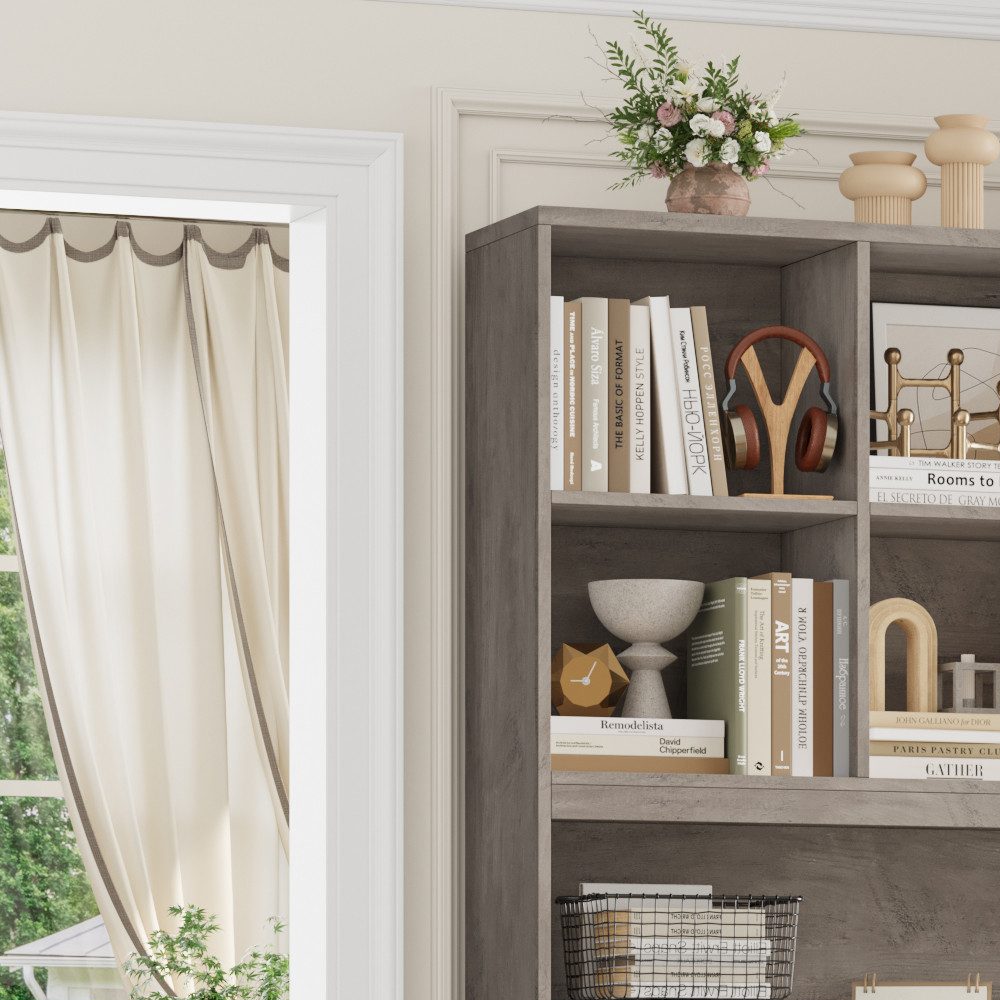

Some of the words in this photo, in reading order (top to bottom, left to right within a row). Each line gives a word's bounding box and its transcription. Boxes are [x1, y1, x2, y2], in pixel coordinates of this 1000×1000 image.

[591, 327, 604, 362] Álvaro
[615, 340, 623, 380] FORMAT
[636, 348, 644, 379] STYLE
[700, 346, 711, 378] РОСС
[591, 364, 602, 385] Siza
[615, 384, 623, 397] OF
[615, 400, 623, 428] BASIC
[636, 383, 644, 425] HOPPEN
[682, 390, 706, 475] НЬЮ-ЙОРК
[705, 384, 722, 461] ЭЛЛЕНХОРН
[615, 430, 623, 449] THE
[636, 428, 644, 460] KELLY
[928, 473, 974, 486] Rooms
[980, 476, 994, 486] to
[891, 492, 936, 503] SECRETO
[940, 494, 952, 504] DE
[958, 495, 985, 506] GRAY
[775, 620, 789, 653] ART
[601, 720, 663, 730] Remodelista
[961, 718, 970, 726] for
[659, 738, 680, 746] David
[659, 746, 706, 755] Chipperfield
[926, 763, 983, 776] GATHER
